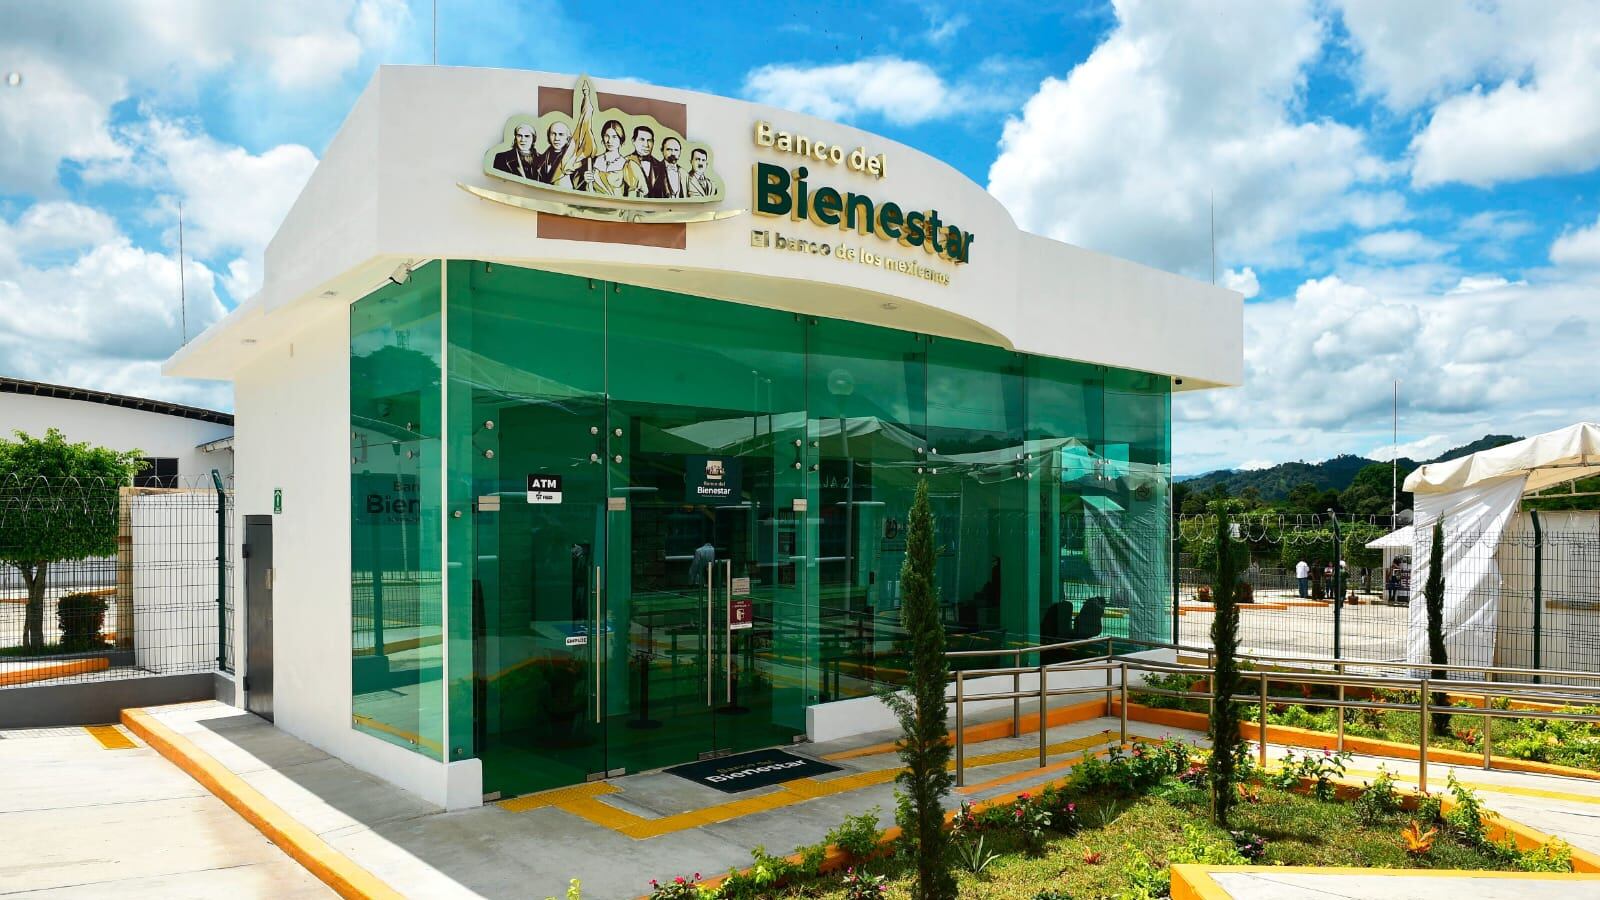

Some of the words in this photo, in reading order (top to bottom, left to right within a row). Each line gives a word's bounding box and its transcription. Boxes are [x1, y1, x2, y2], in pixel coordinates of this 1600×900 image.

[754, 120, 844, 167] Banco
[847, 146, 887, 179] del
[752, 161, 975, 265] Bienestar
[751, 229, 770, 248] El
[775, 231, 831, 257] banco
[835, 243, 855, 261] de
[859, 247, 882, 267] los
[884, 256, 951, 287] mexicanos
[532, 478, 557, 489] ATM
[697, 486, 731, 495] Bienestar
[704, 759, 808, 784] Bienestar
